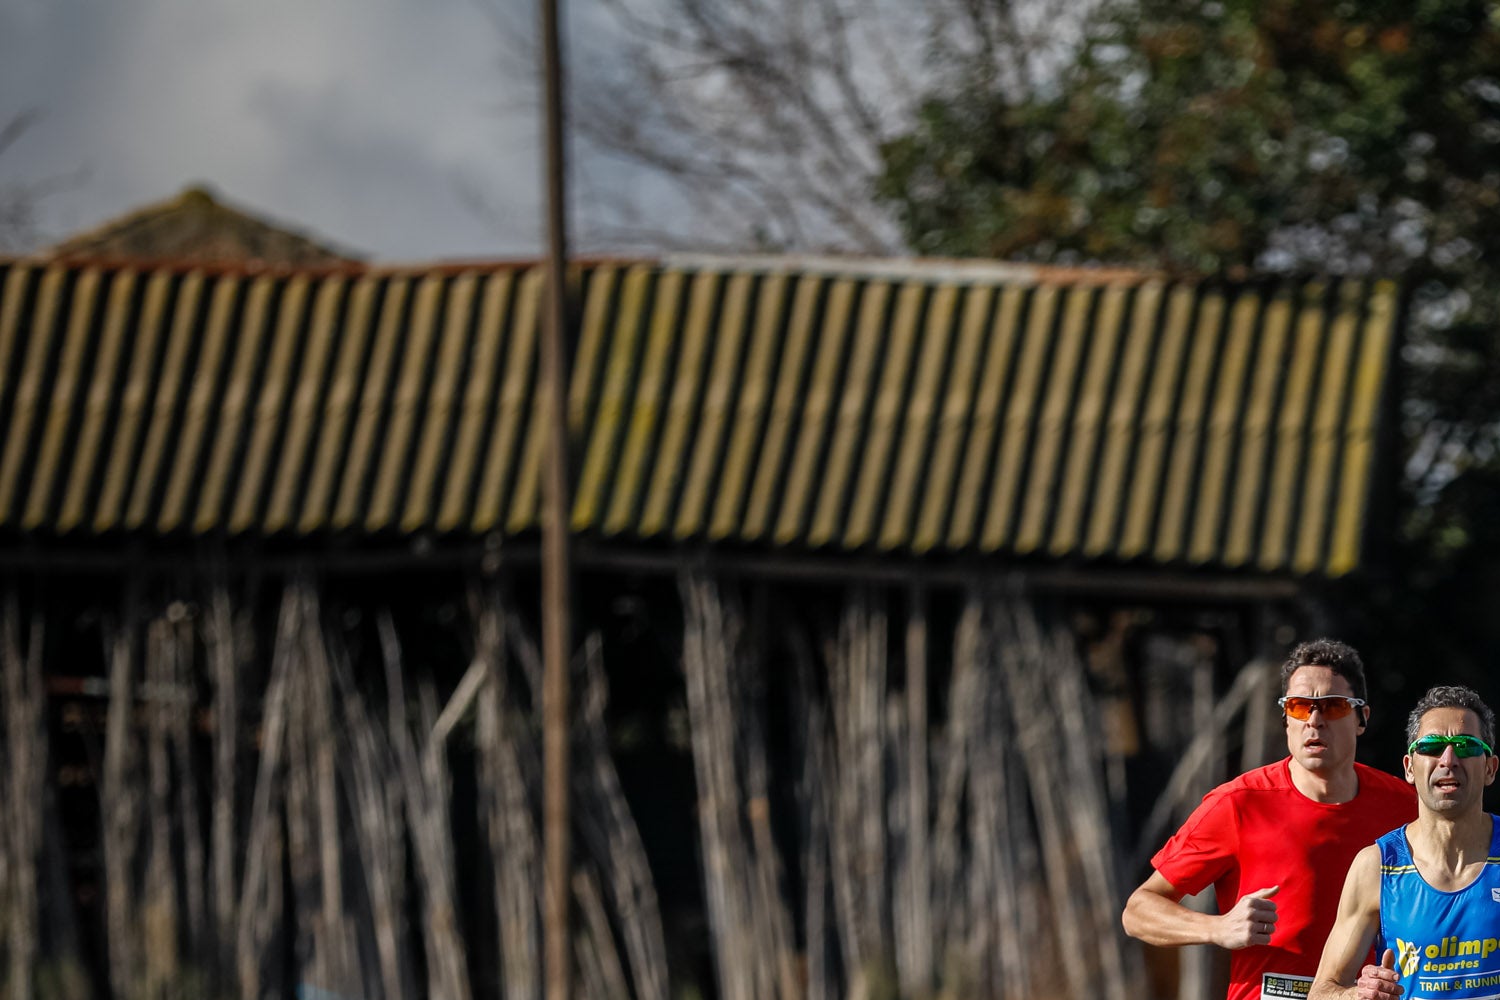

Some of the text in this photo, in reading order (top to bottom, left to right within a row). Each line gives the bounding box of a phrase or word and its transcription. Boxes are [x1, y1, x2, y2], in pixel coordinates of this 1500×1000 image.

[1423, 960, 1479, 973] deportes
[1420, 981, 1451, 991] TRAIL
[1454, 981, 1462, 990] &
